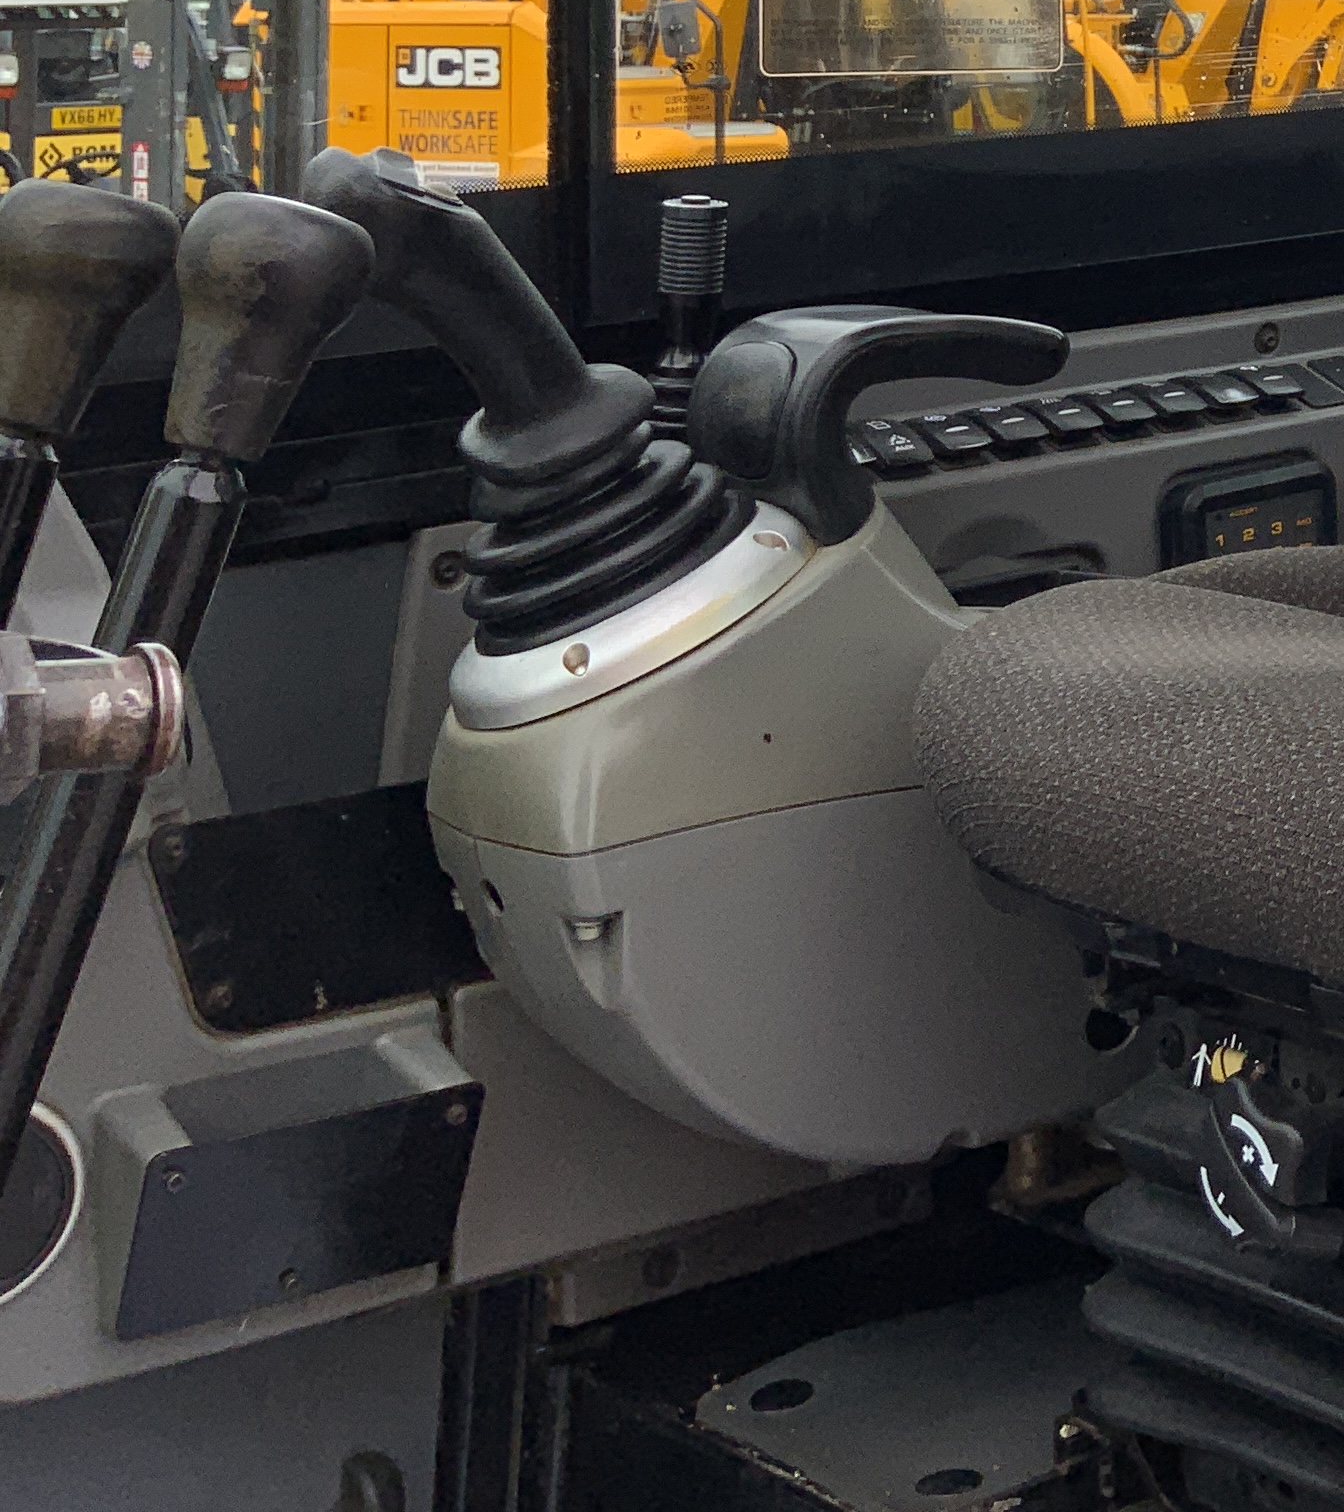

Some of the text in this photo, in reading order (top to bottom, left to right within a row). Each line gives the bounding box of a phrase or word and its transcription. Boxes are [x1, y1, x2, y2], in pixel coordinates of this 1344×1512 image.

[397, 47, 501, 87] JCB
[60, 108, 121, 125] VX66 HY
[398, 108, 499, 131] THINKSAFE
[399, 133, 499, 155] WORKSAFE
[1215, 533, 1224, 547] 1
[1242, 526, 1256, 542] 2
[1271, 520, 1283, 535] 3
